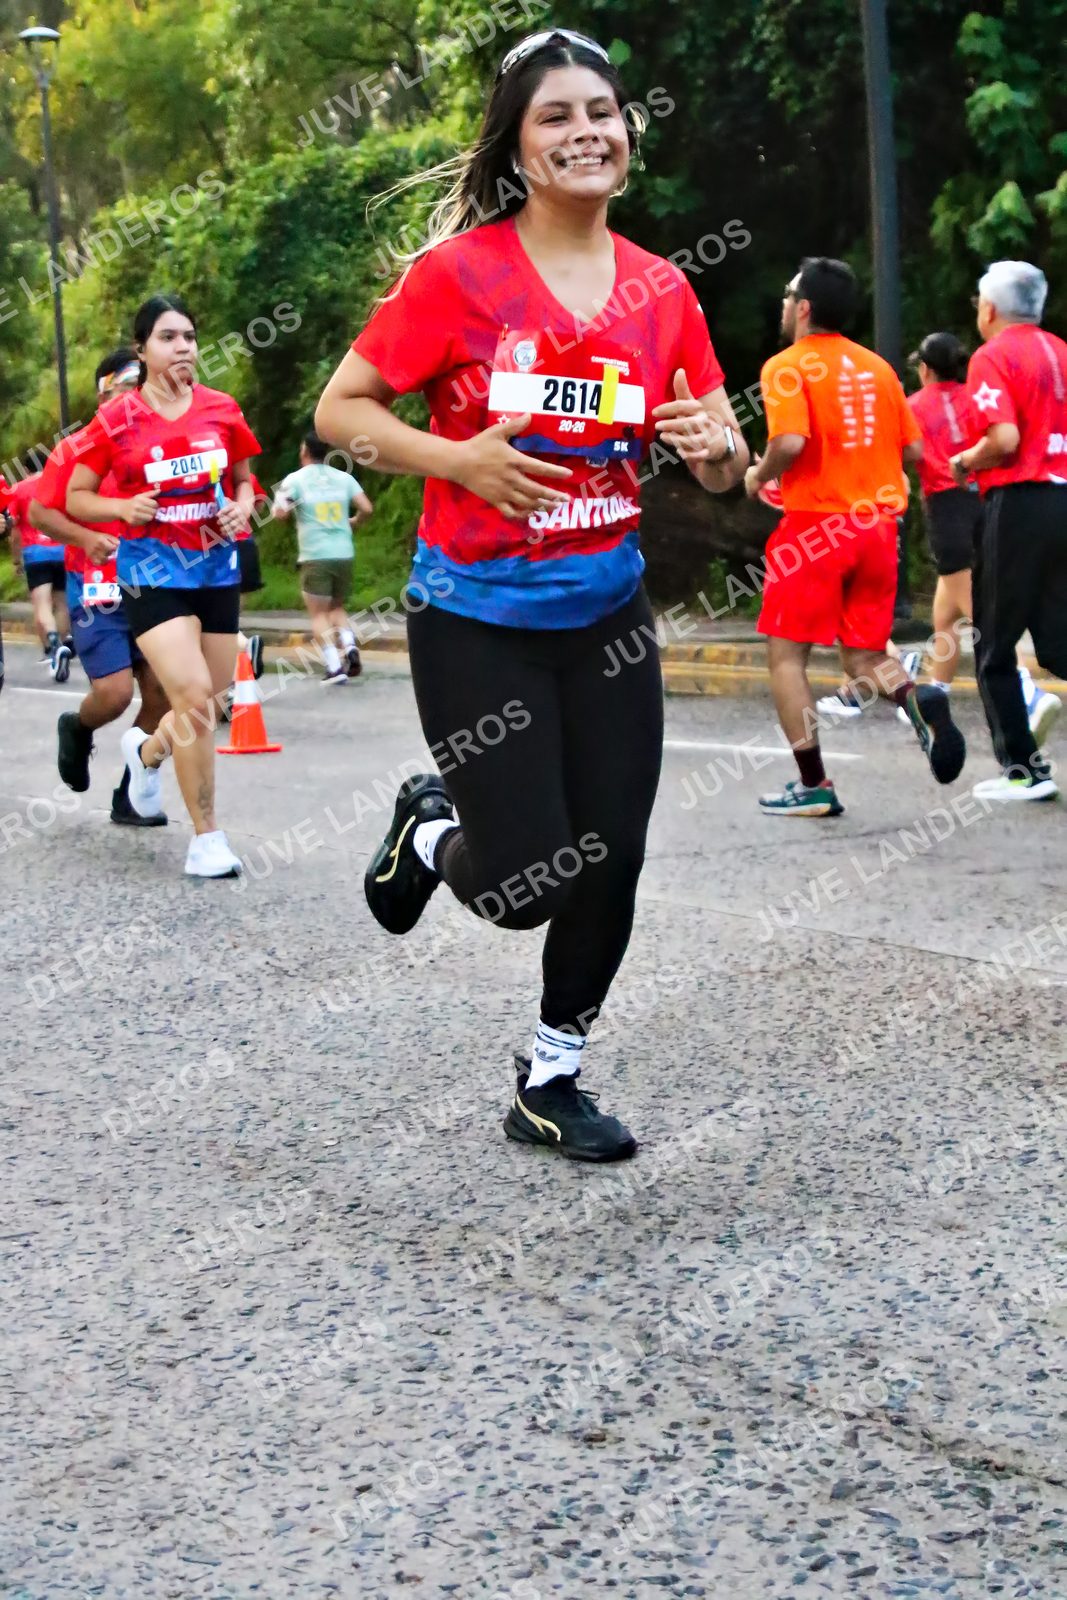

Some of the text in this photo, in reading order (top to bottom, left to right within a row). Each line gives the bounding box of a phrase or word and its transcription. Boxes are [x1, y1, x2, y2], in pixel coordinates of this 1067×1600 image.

[543, 379, 603, 415] 2614
[613, 440, 629, 452] 5K
[170, 455, 204, 477] 2041
